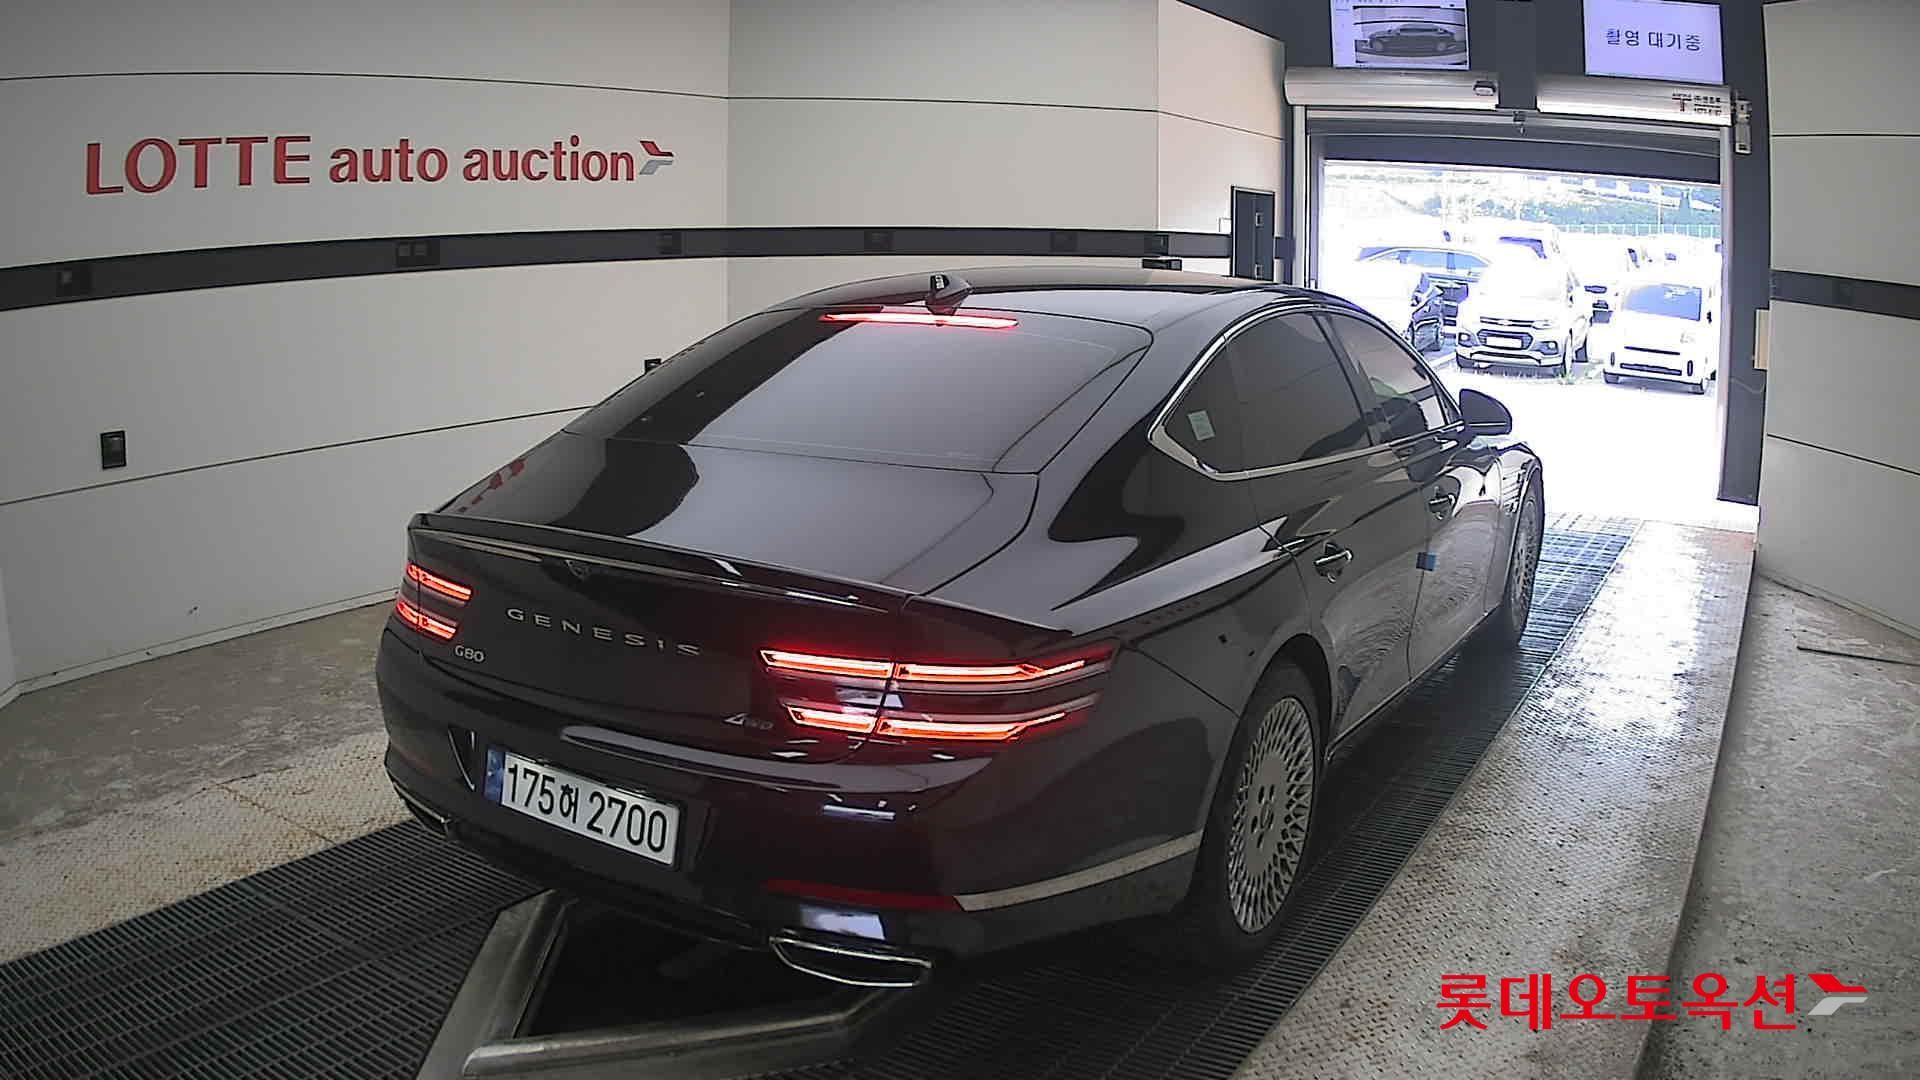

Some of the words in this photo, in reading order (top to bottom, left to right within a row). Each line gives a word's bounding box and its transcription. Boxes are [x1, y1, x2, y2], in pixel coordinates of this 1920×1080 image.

[1648, 31, 1701, 52] 대기중
[86, 135, 311, 195] LOTTE
[329, 138, 449, 183] auto
[463, 135, 636, 183] auction
[454, 645, 486, 663] G80
[506, 607, 701, 657] GENESIS
[508, 763, 580, 824] 175허
[586, 790, 667, 853] 2700
